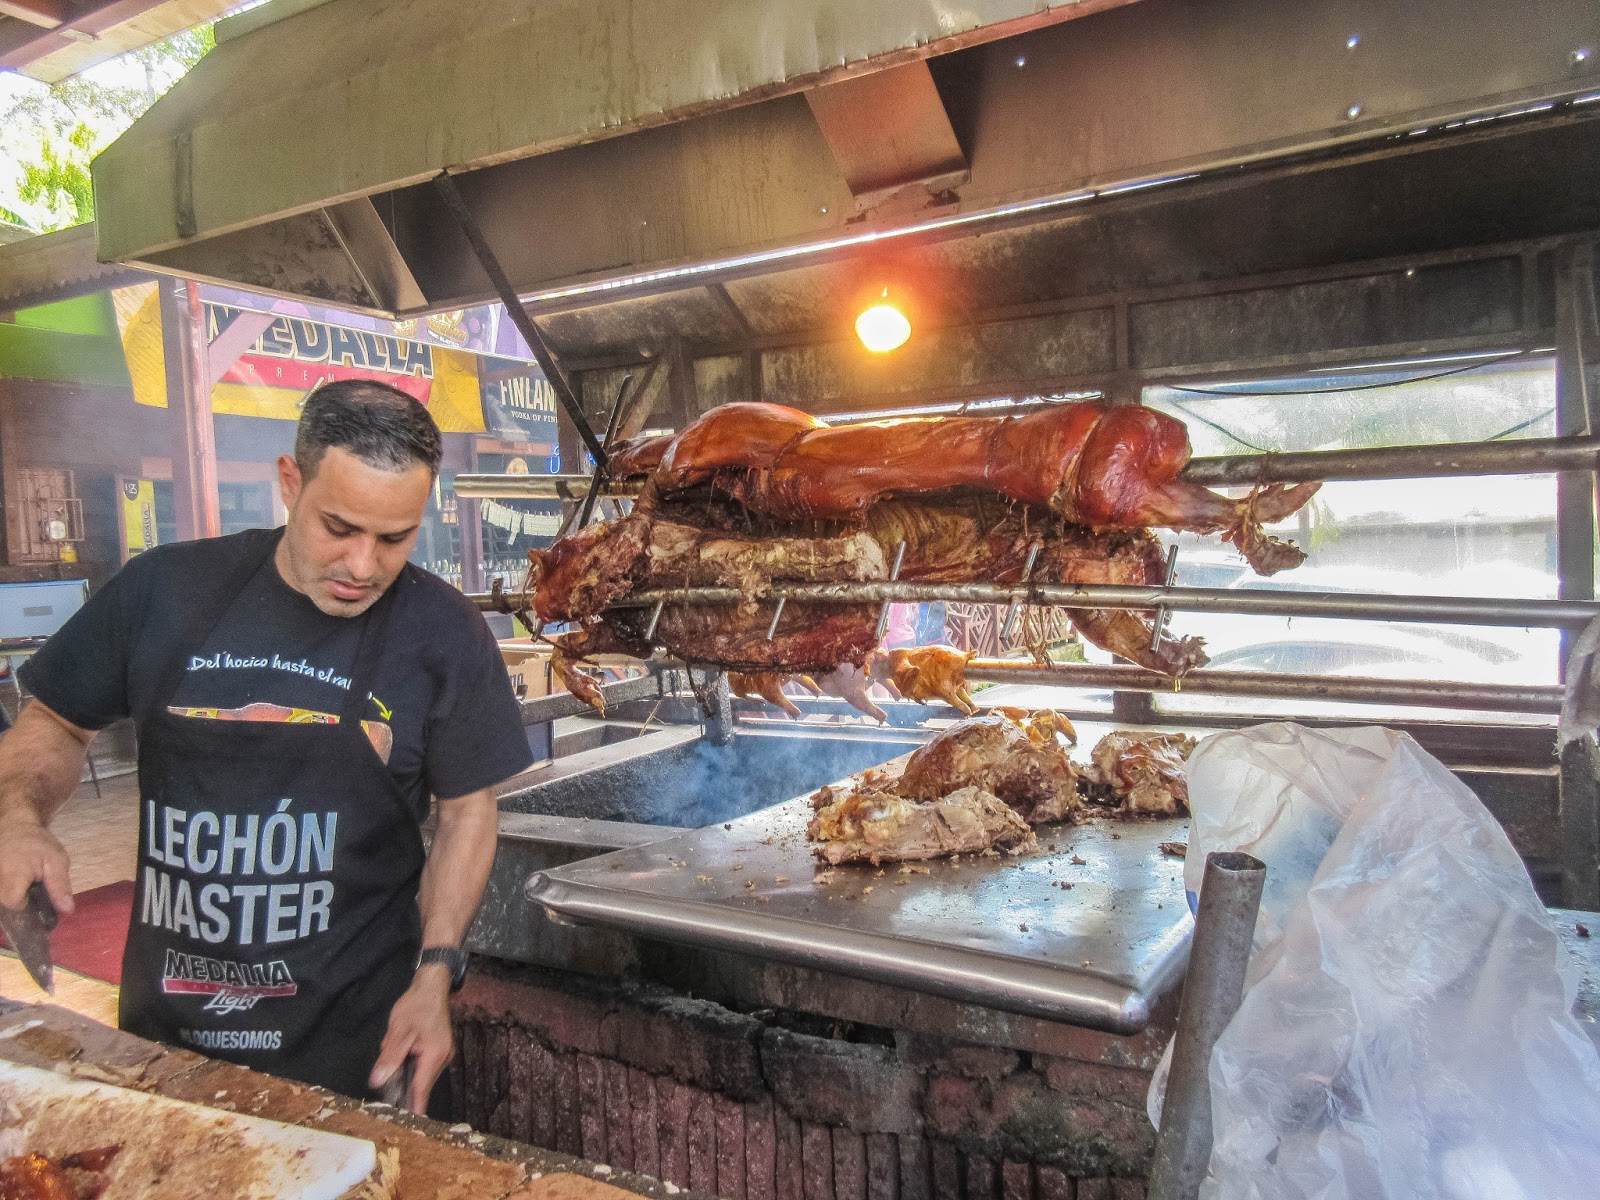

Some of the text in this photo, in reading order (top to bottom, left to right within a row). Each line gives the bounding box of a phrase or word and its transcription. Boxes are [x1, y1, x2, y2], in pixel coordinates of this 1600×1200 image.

[500, 377, 557, 412] FINLAN
[511, 410, 530, 420] VODKA
[532, 413, 541, 421] OF
[272, 654, 314, 677] hasta
[318, 668, 334, 682] el
[147, 798, 338, 875] LECHÓN
[142, 866, 335, 945] MASTER
[163, 948, 295, 988] MEDALLA
[203, 989, 263, 1015] Light
